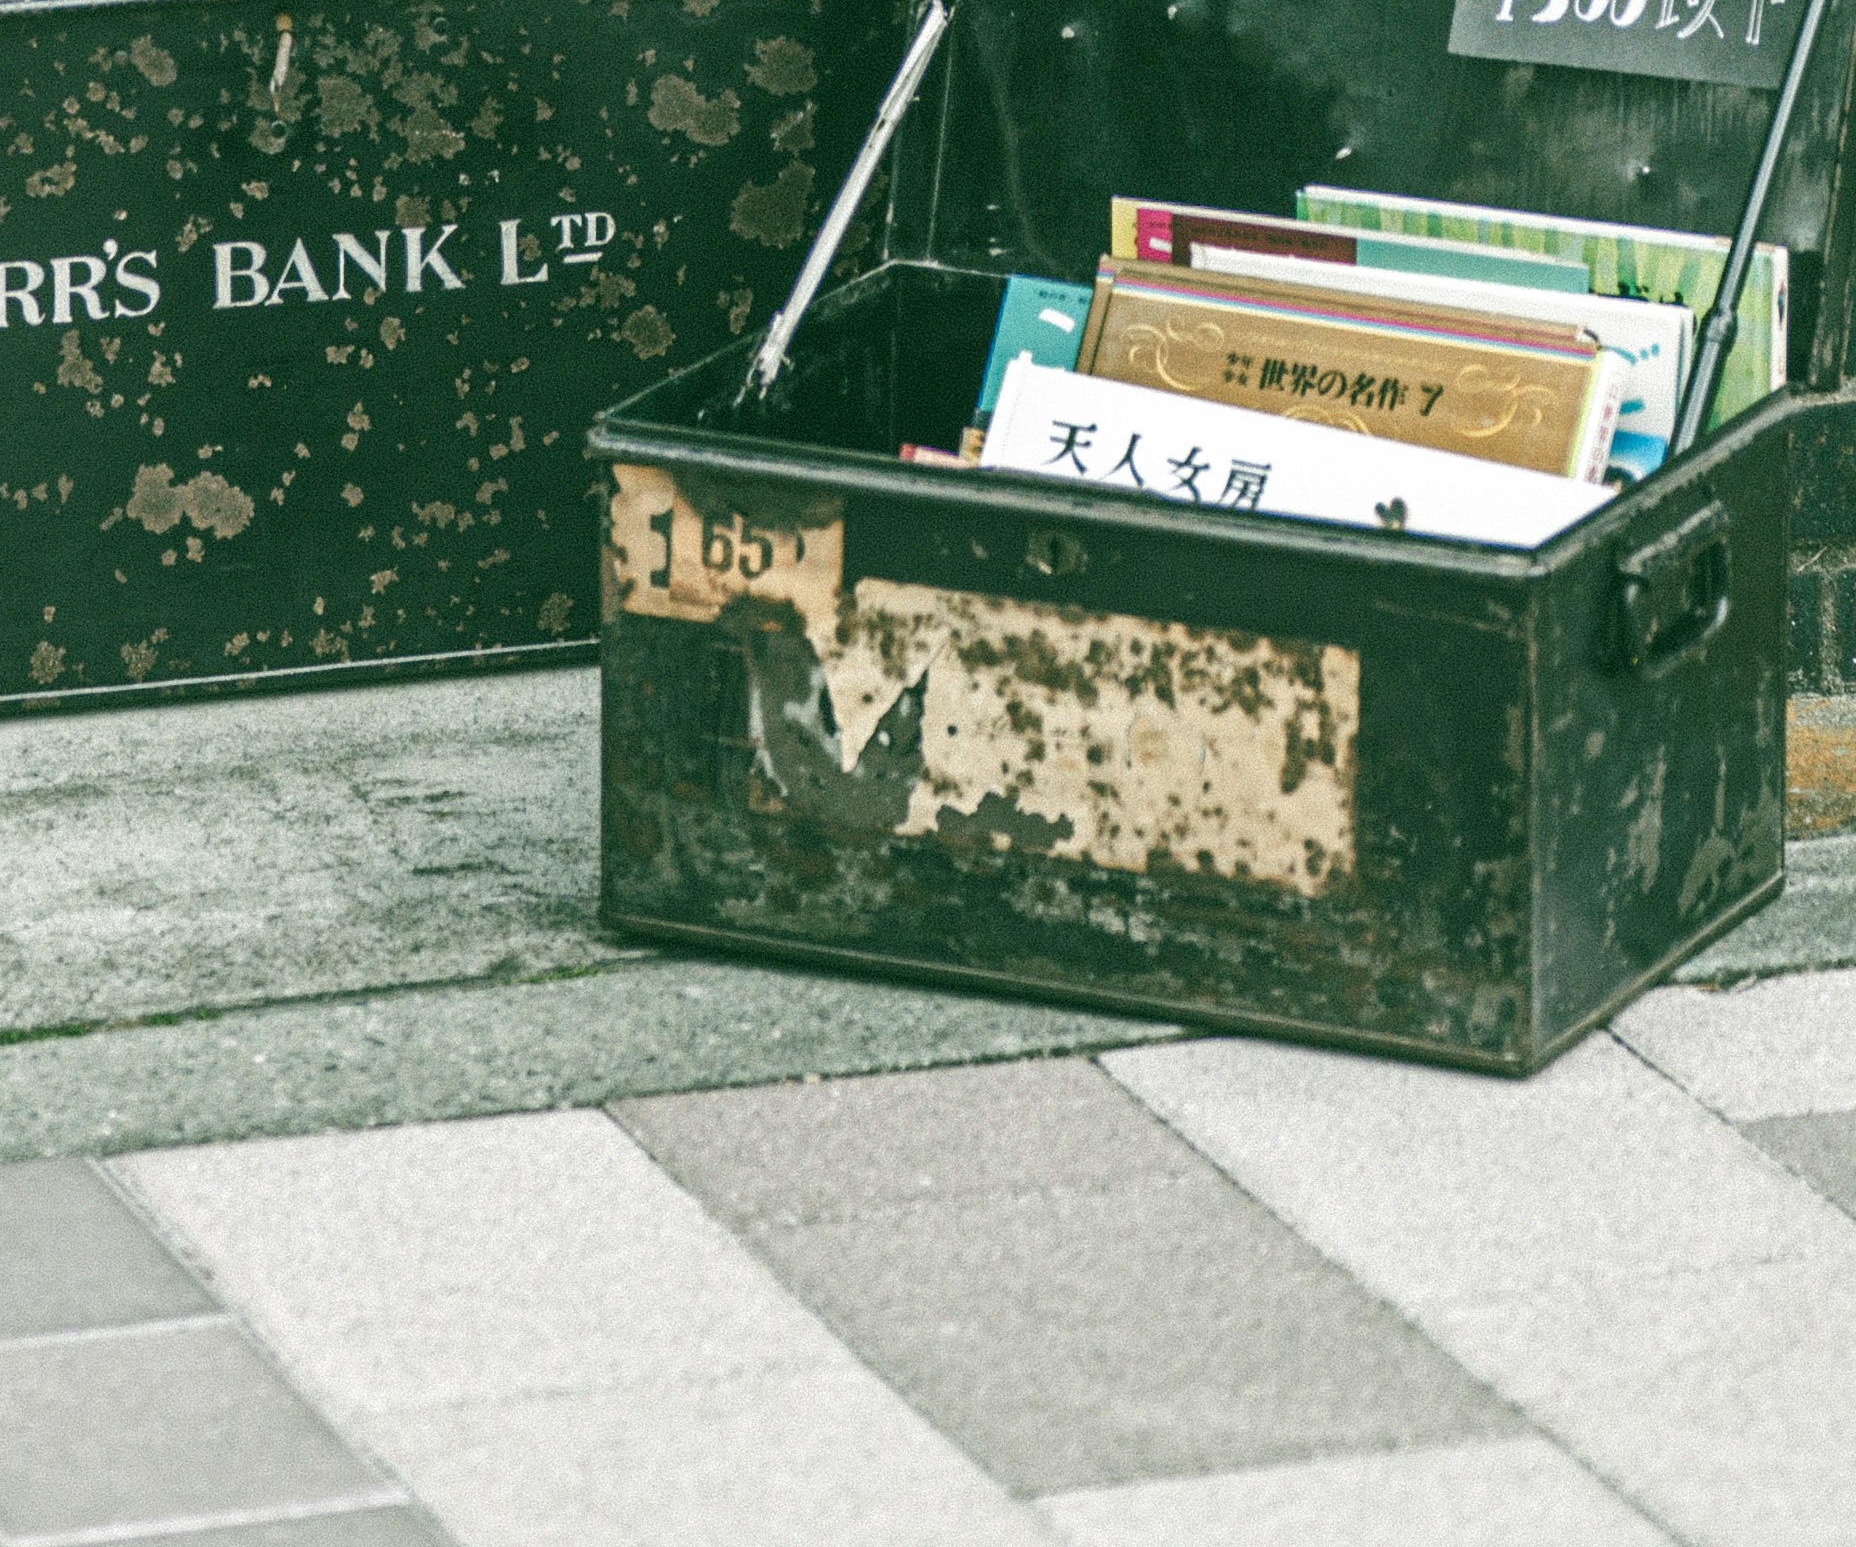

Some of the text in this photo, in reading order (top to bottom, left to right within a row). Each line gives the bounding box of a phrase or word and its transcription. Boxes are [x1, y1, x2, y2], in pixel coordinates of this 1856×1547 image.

[212, 223, 466, 309] BANK
[1258, 358, 1444, 417] 世界の名作 7
[1043, 409, 1273, 509] 天人女房
